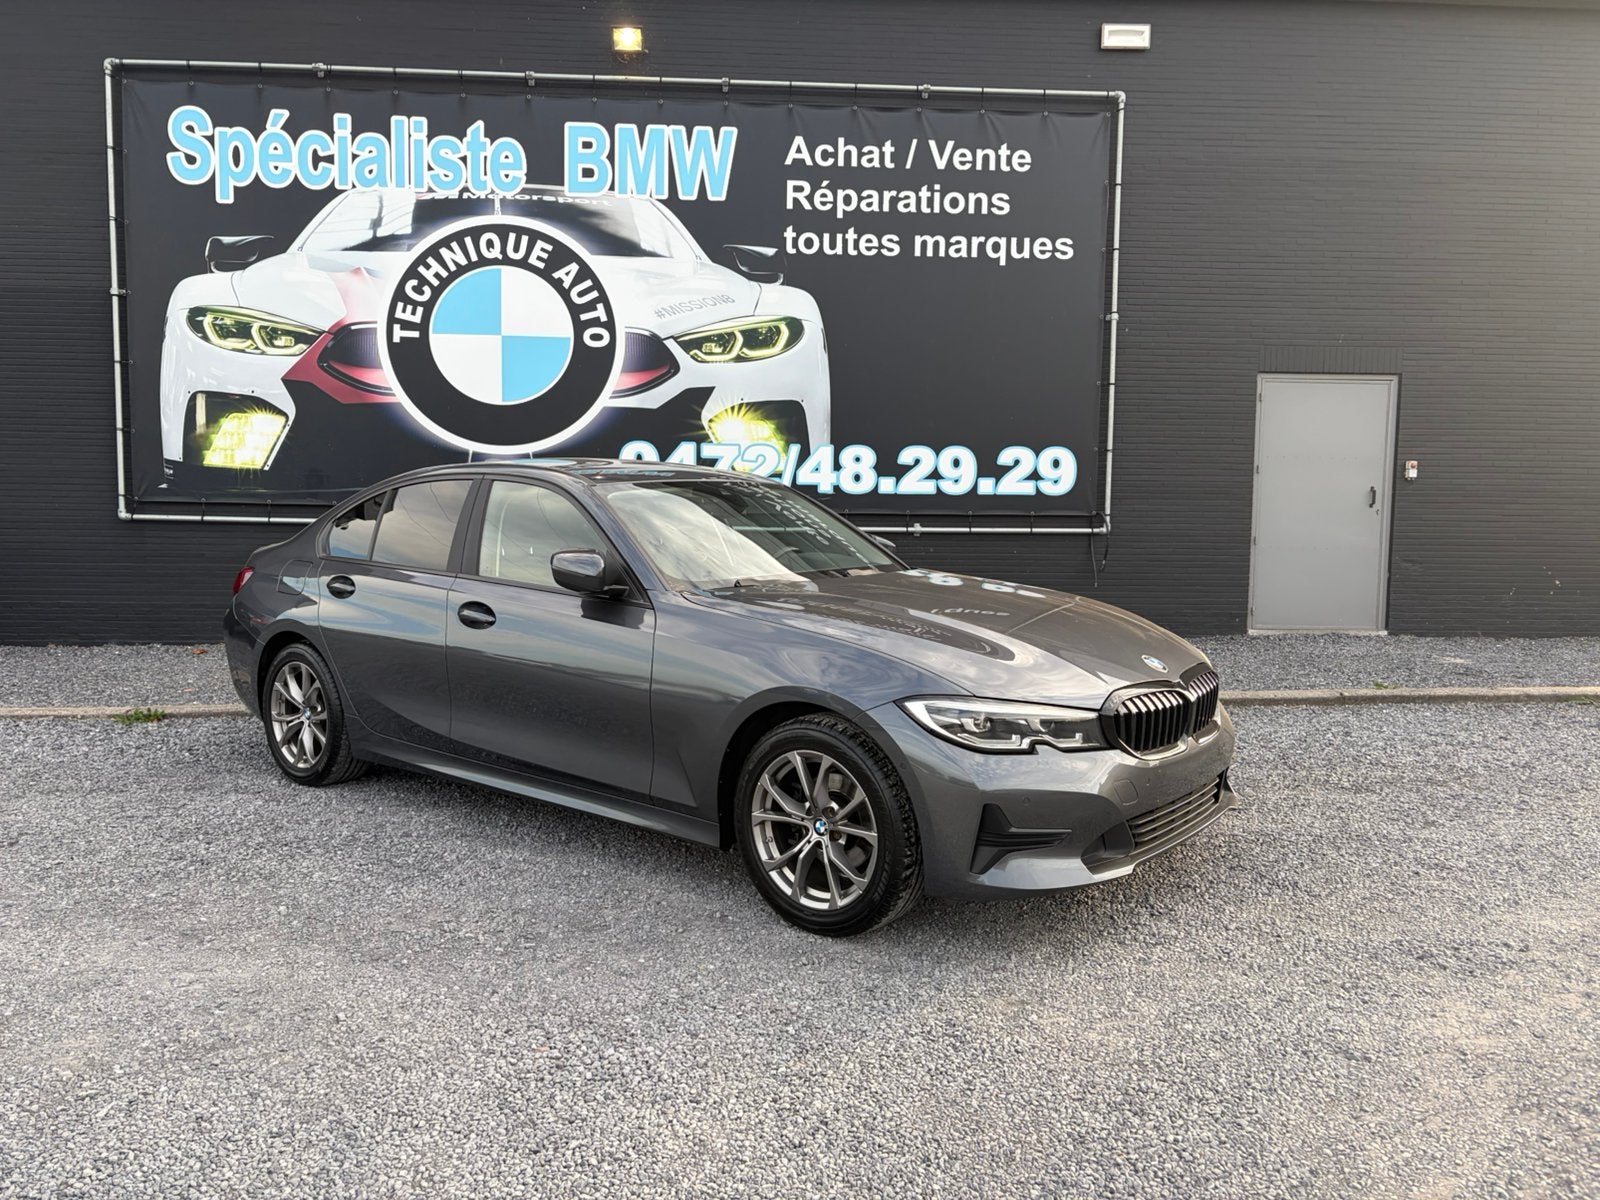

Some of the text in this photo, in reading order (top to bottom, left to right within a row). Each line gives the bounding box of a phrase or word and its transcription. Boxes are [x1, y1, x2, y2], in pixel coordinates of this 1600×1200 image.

[166, 105, 738, 204] Spécialiste BMW
[784, 135, 1032, 172] Achat / Vente
[786, 180, 1011, 219] Réparations
[783, 225, 1074, 266] toutes marques
[392, 231, 611, 348] TECHNIQUE AUTO
